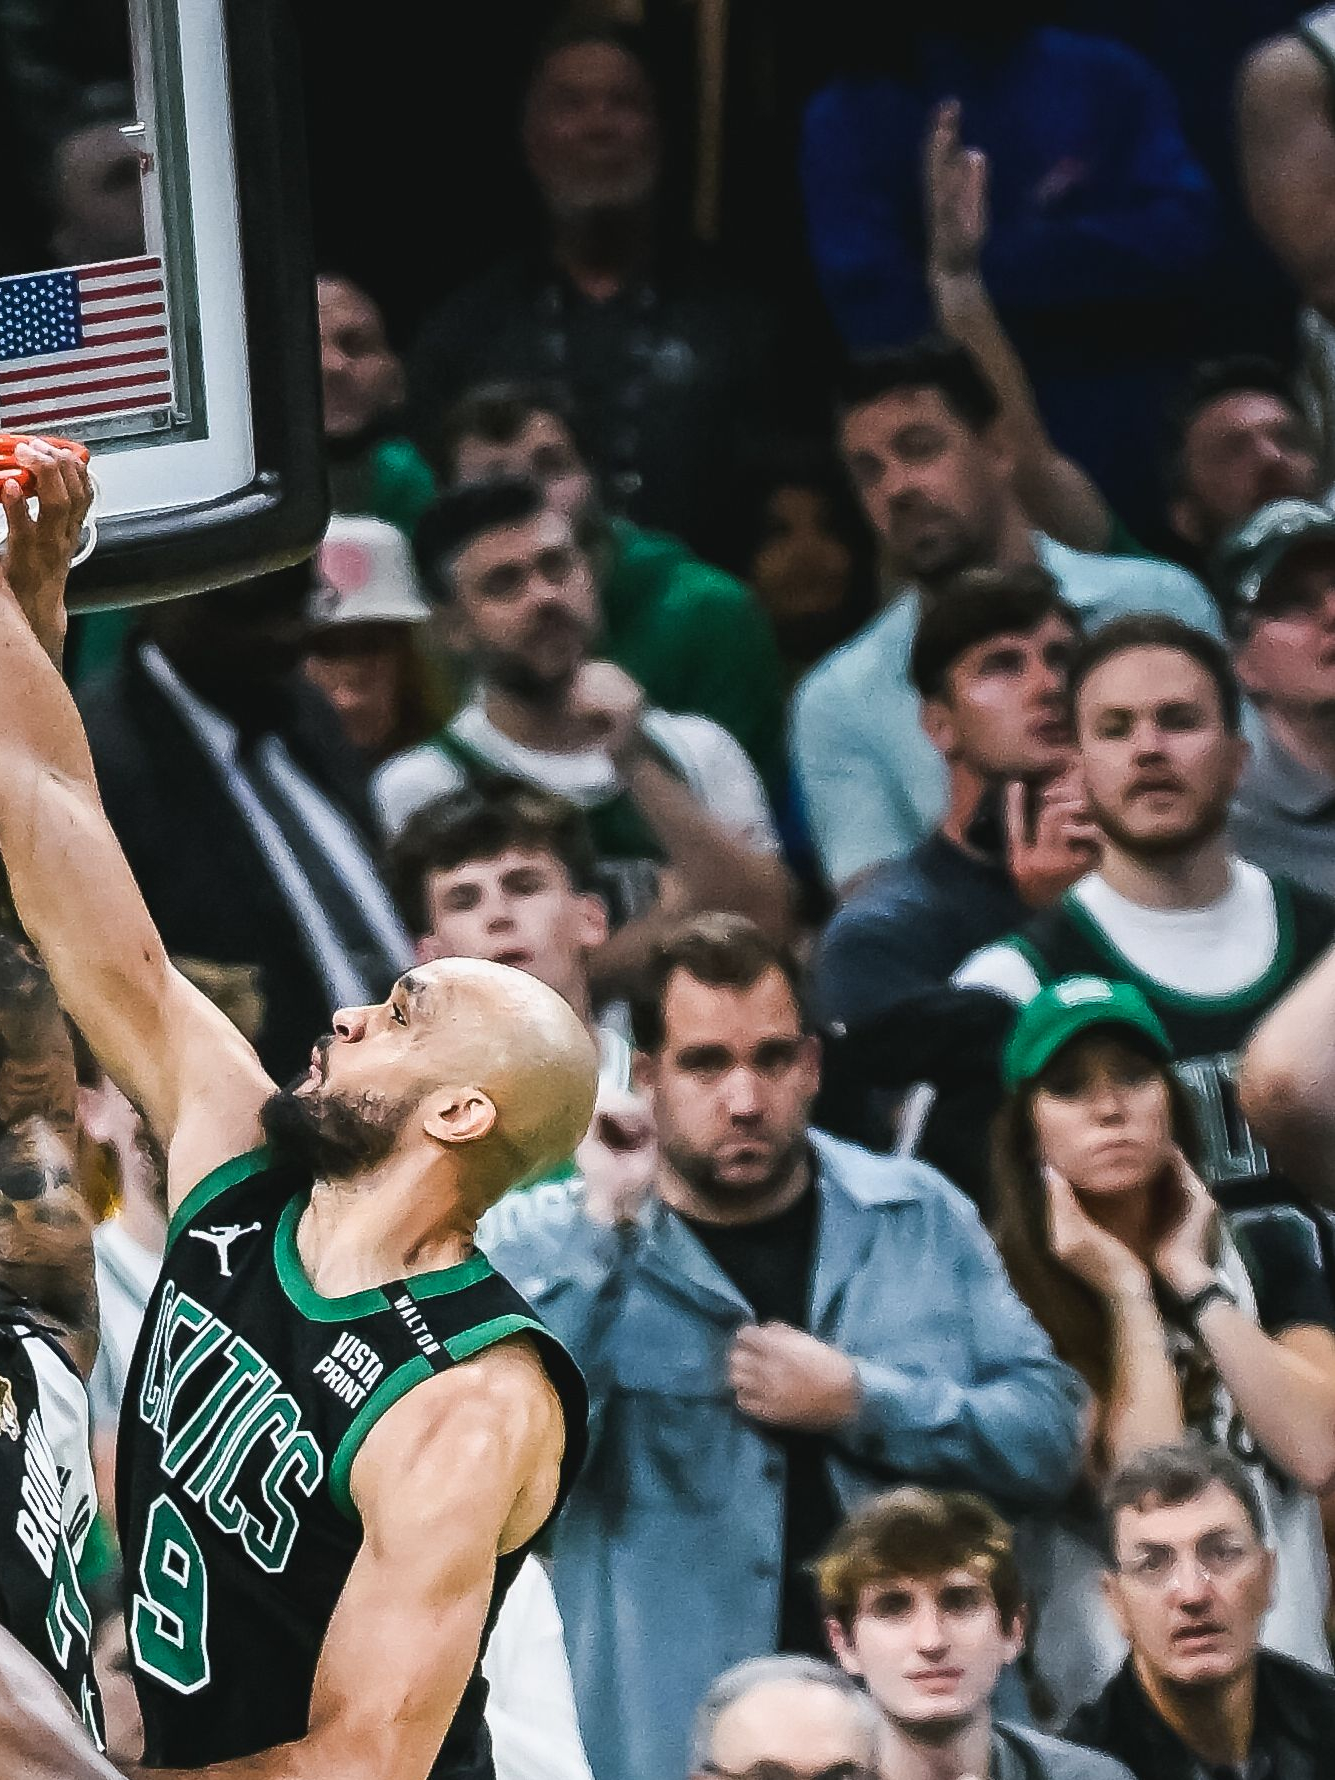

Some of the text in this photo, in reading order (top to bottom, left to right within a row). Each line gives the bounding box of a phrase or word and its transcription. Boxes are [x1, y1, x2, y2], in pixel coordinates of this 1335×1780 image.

[394, 1294, 441, 1356] WALTON
[312, 1355, 367, 1409] PRINT
[330, 1331, 384, 1392] VISTA
[130, 1493, 211, 1695] 9
